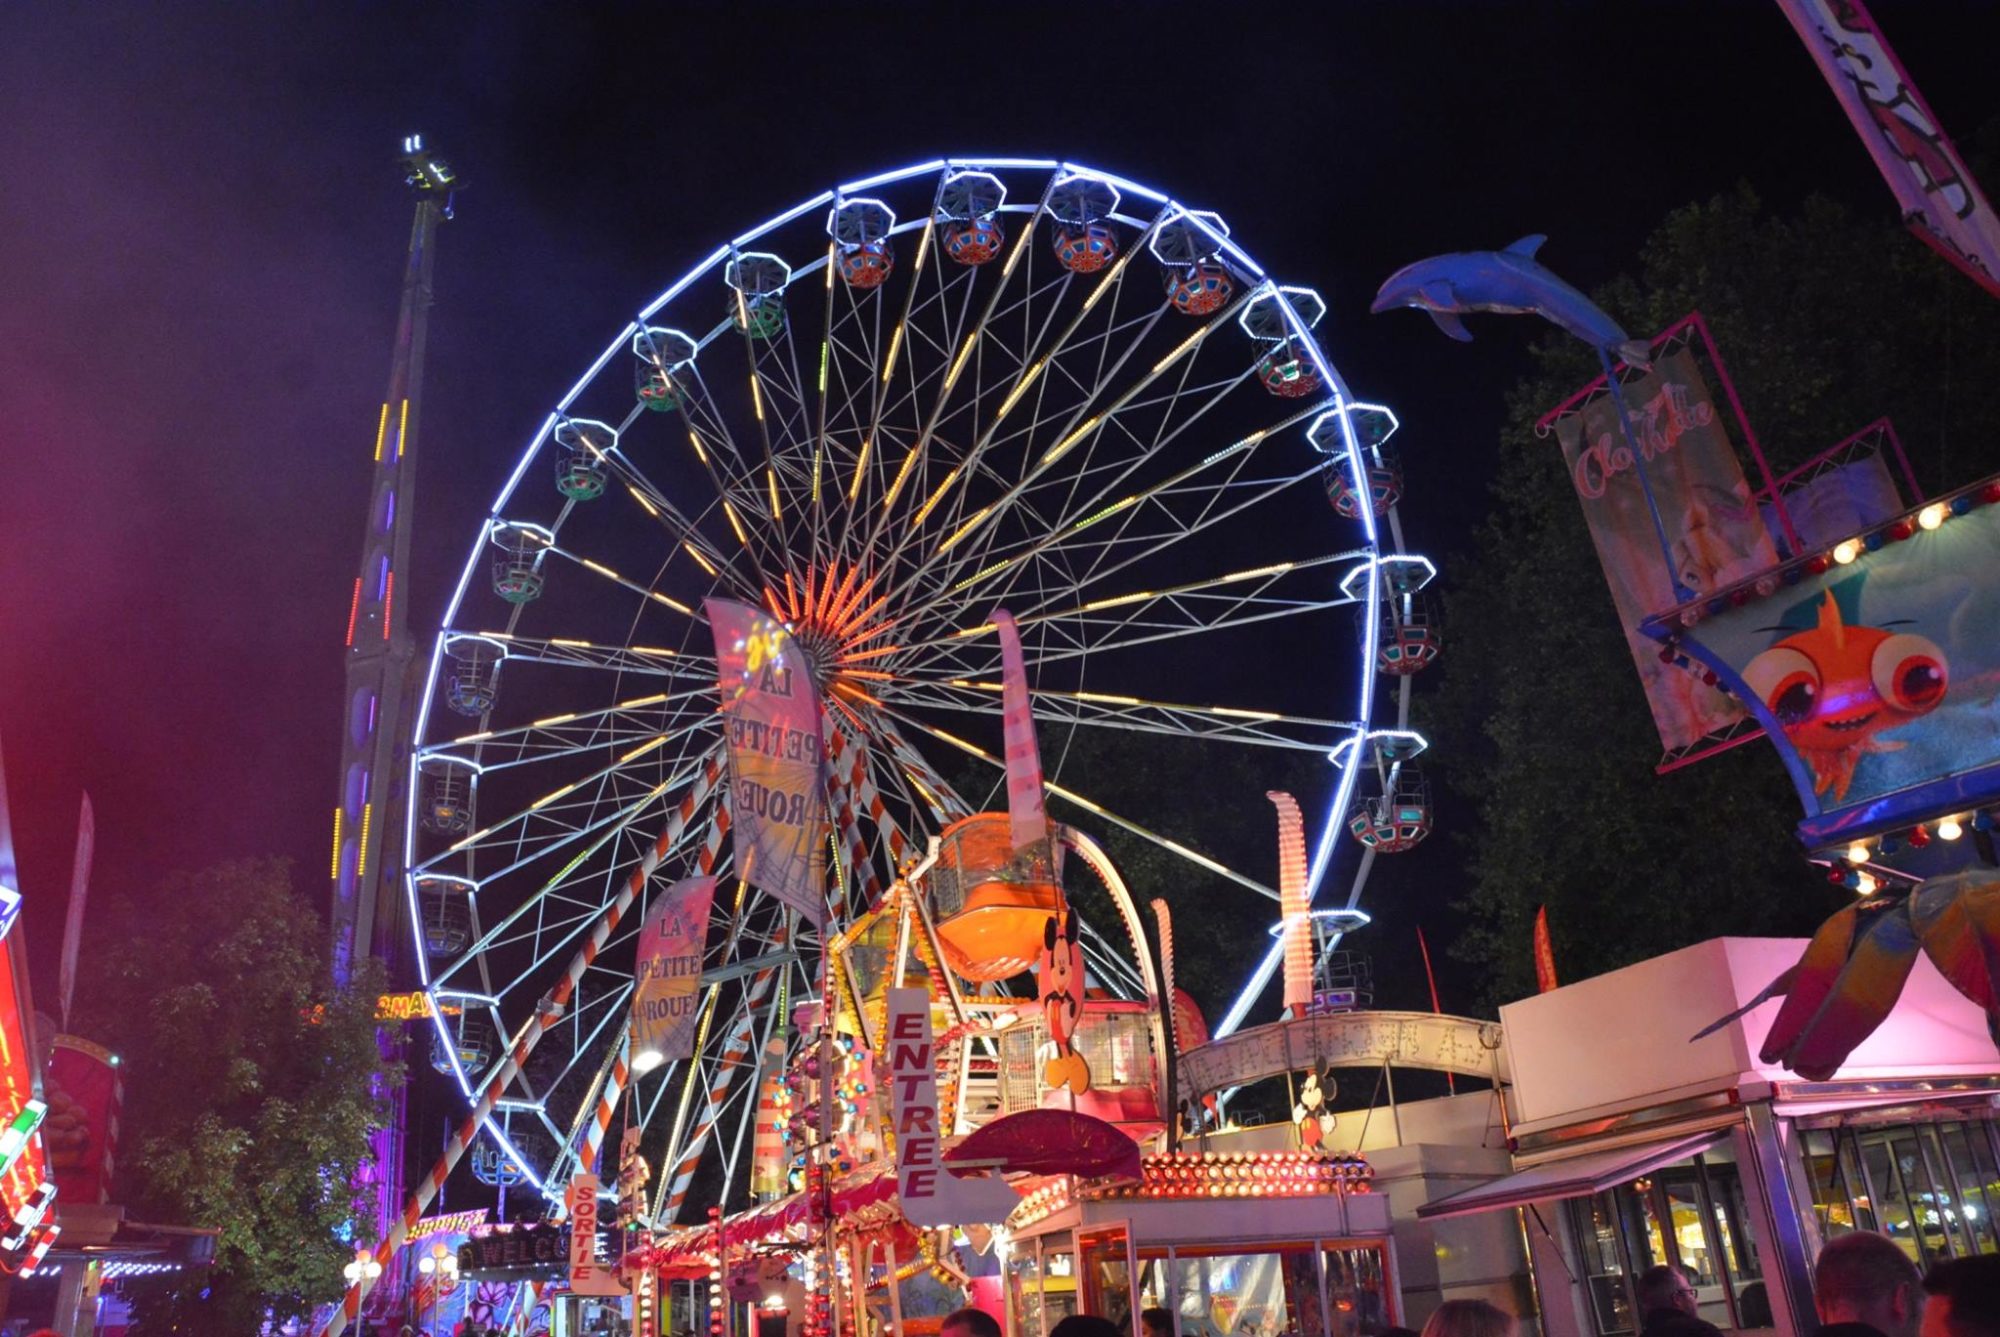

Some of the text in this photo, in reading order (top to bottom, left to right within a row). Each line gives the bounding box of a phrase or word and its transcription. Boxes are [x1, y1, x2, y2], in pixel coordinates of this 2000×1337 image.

[660, 918, 682, 938] LA
[640, 954, 700, 980] PETITE
[646, 995, 694, 1021] ROUE
[893, 1013, 937, 1198] ENTREE
[573, 1187, 595, 1280] SORTIE
